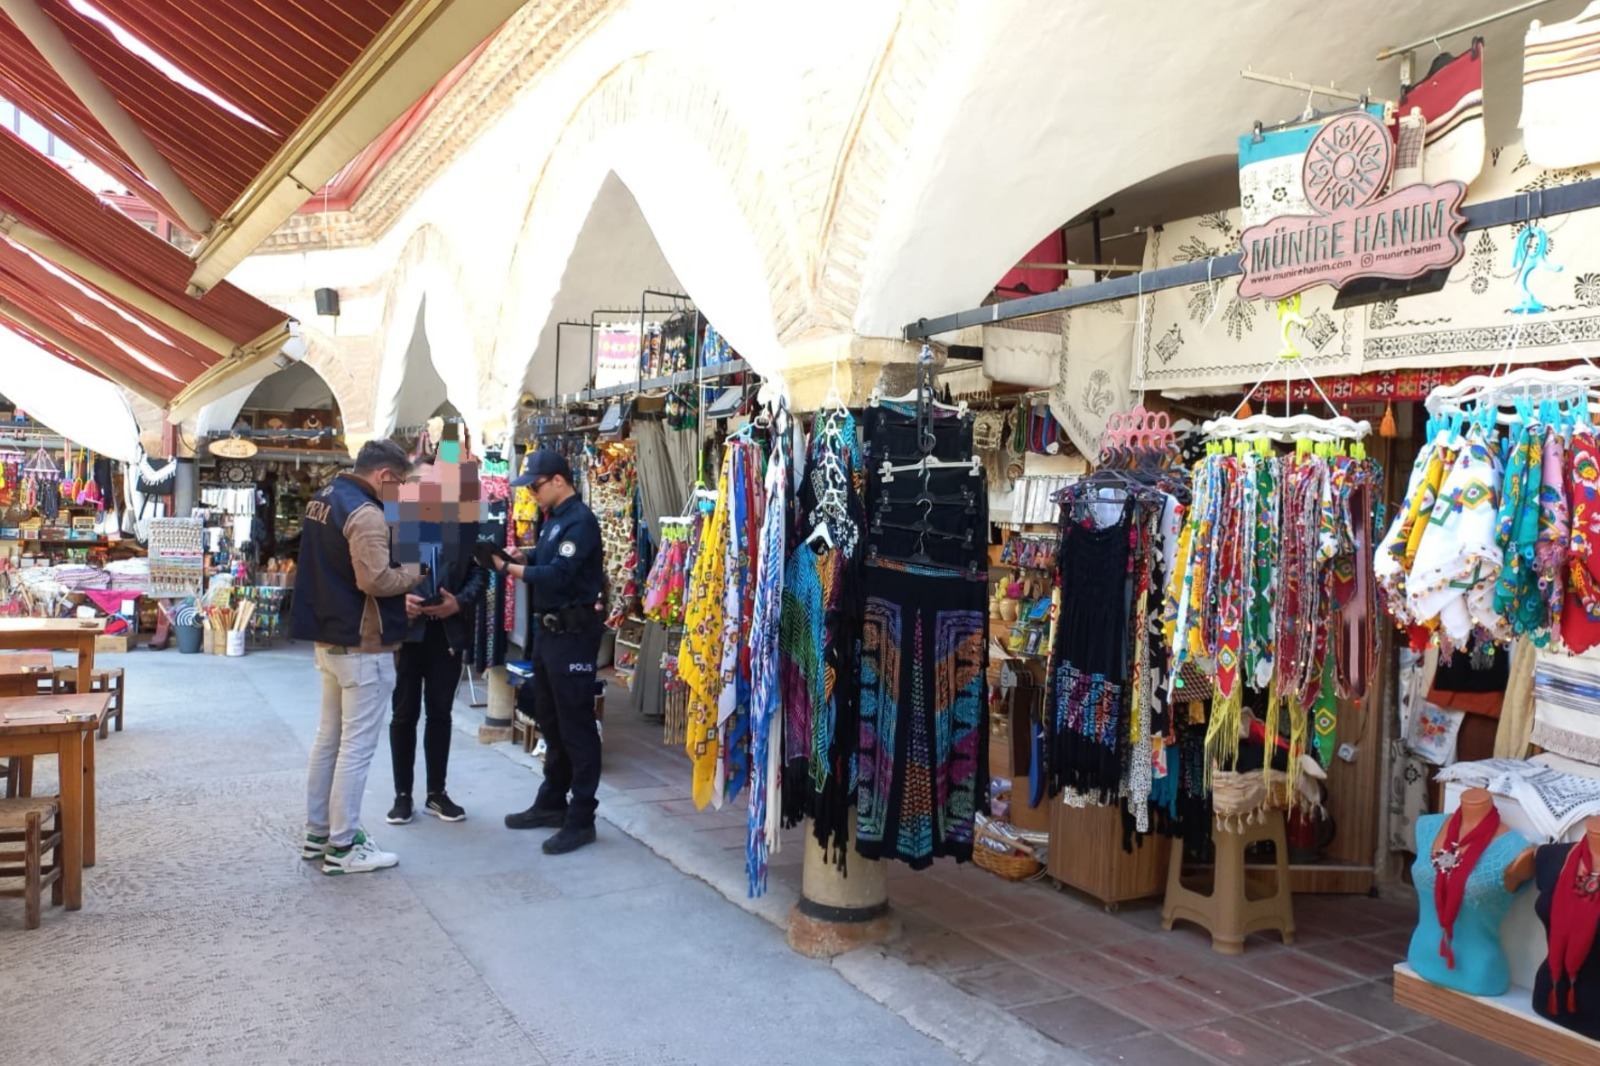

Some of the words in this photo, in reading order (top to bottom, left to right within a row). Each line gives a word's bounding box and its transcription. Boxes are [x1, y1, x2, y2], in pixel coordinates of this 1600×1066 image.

[1250, 220, 1346, 274] MÜNİRE
[1353, 199, 1446, 254] HANIM
[1250, 260, 1352, 284] www.munirehanim.com
[1375, 243, 1441, 261] munirehanim
